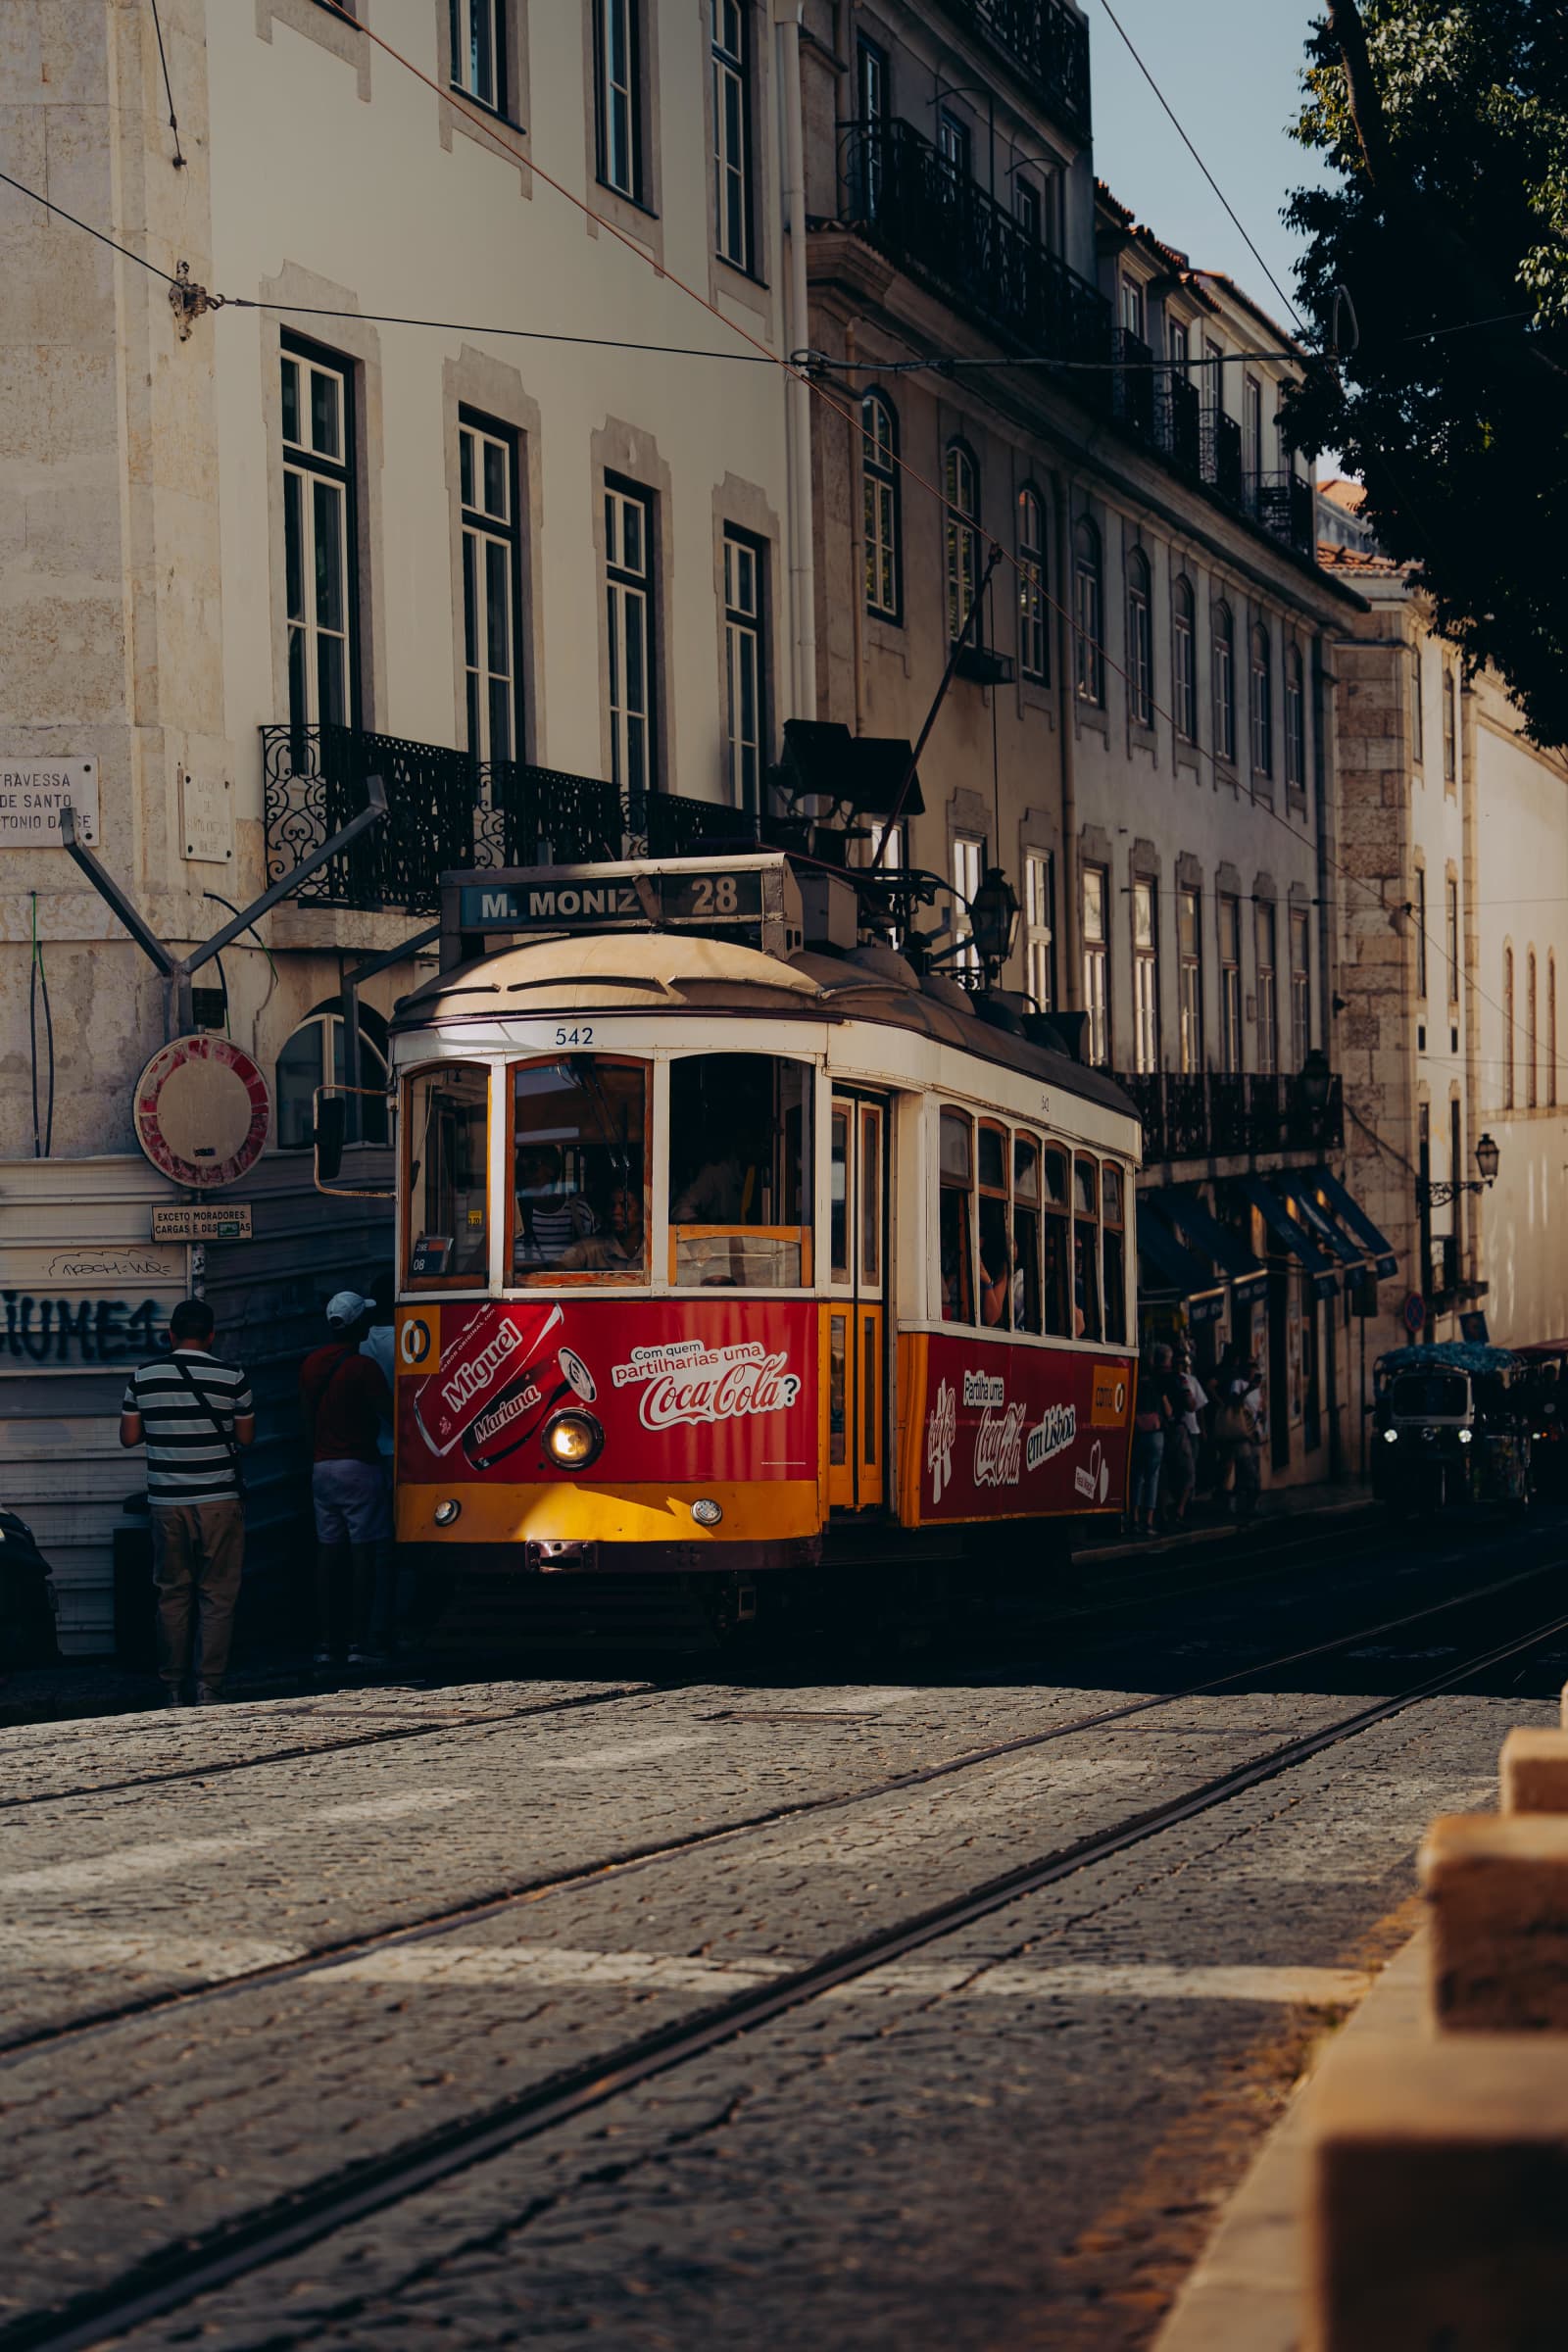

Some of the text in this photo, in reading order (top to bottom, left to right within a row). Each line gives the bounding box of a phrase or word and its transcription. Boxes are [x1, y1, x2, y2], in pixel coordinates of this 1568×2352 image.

[0, 794, 72, 808] DE SANTO
[0, 815, 41, 829] TONIO
[481, 876, 737, 918] M. MONIZ 28
[556, 1027, 594, 1046] 542
[158, 1210, 245, 1222] EXCETO MORADORES
[155, 1224, 189, 1234] CARGAS
[193, 1224, 198, 1233] E
[202, 1223, 251, 1233] DESAS
[634, 1343, 701, 1360] Com quem
[441, 1317, 523, 1413] Miguel
[615, 1345, 761, 1383] partilharias uma
[964, 1377, 1004, 1400] Partilha uma
[473, 1385, 542, 1444] Mariana
[1027, 1409, 1075, 1464] em Lisboa
